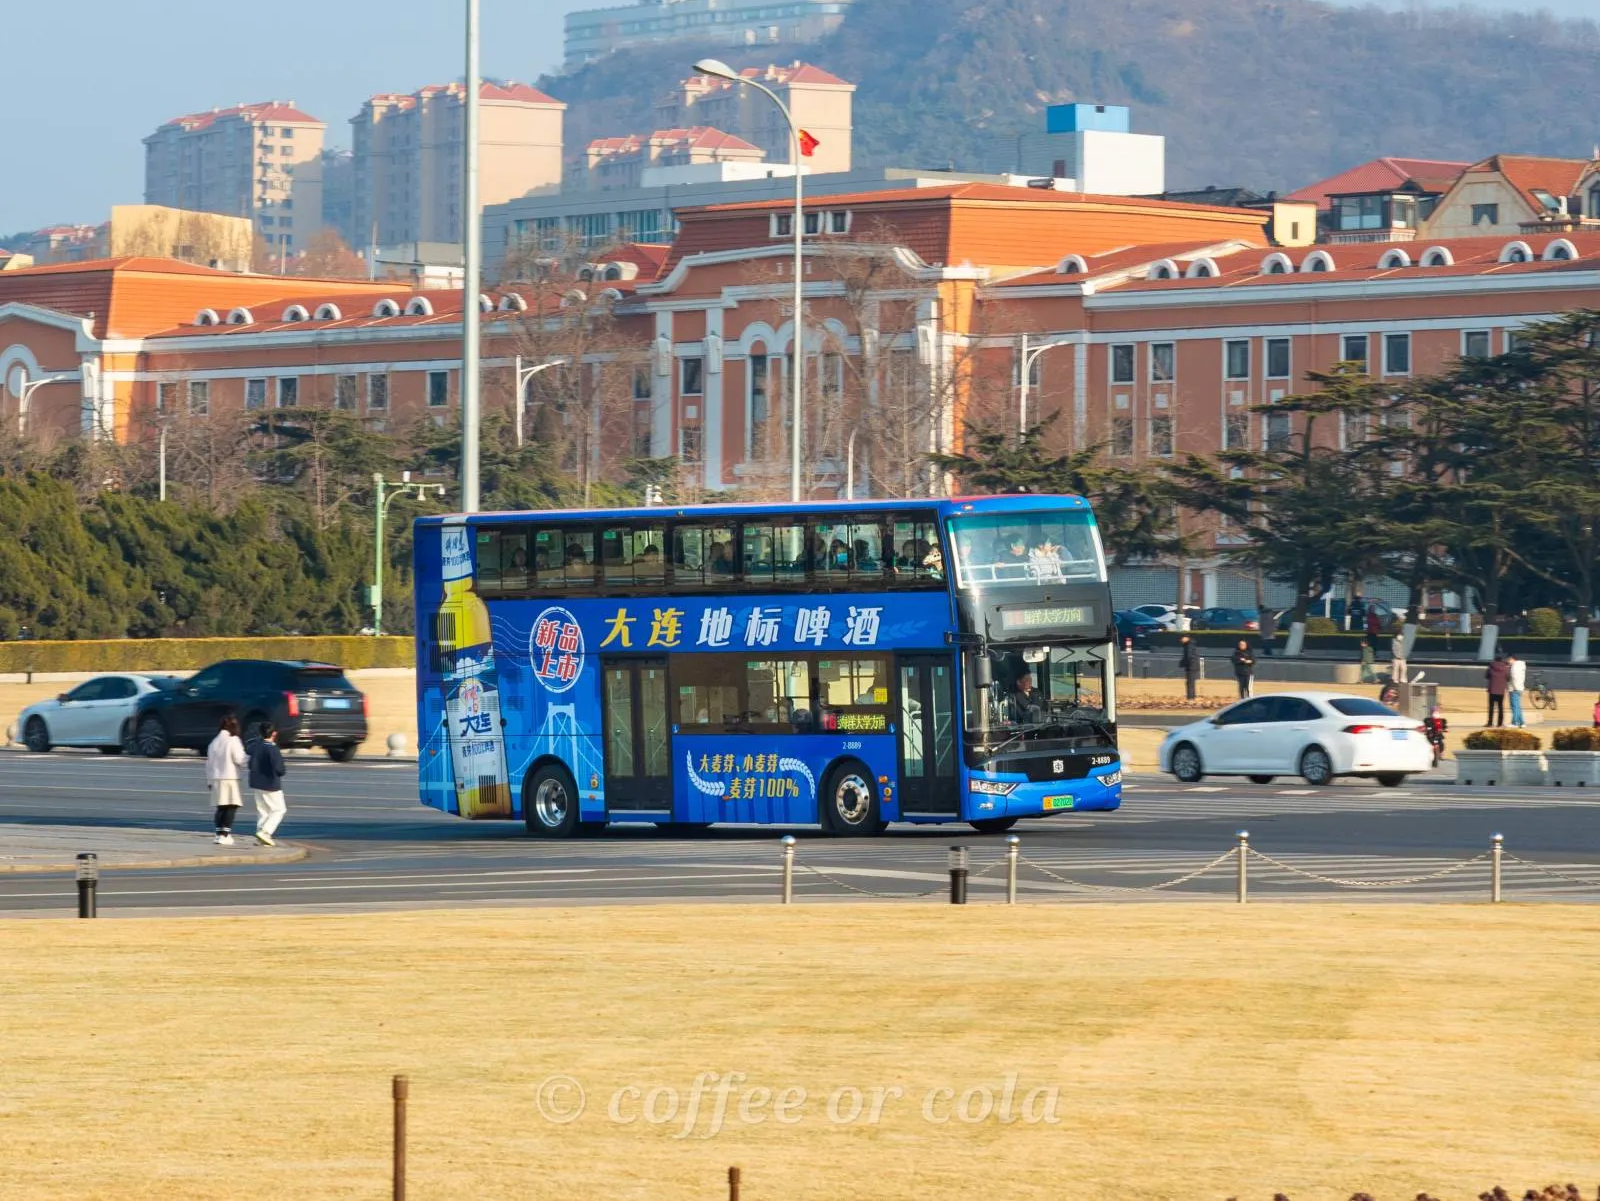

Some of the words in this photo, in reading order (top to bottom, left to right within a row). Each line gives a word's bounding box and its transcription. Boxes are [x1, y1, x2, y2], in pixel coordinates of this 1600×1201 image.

[536, 618, 580, 653] 新品
[600, 606, 883, 647] 大连地标啤酒
[536, 649, 579, 682] 上市
[699, 754, 778, 773] 大麦芽、小麦芽
[729, 777, 799, 799] 麦芽100%
